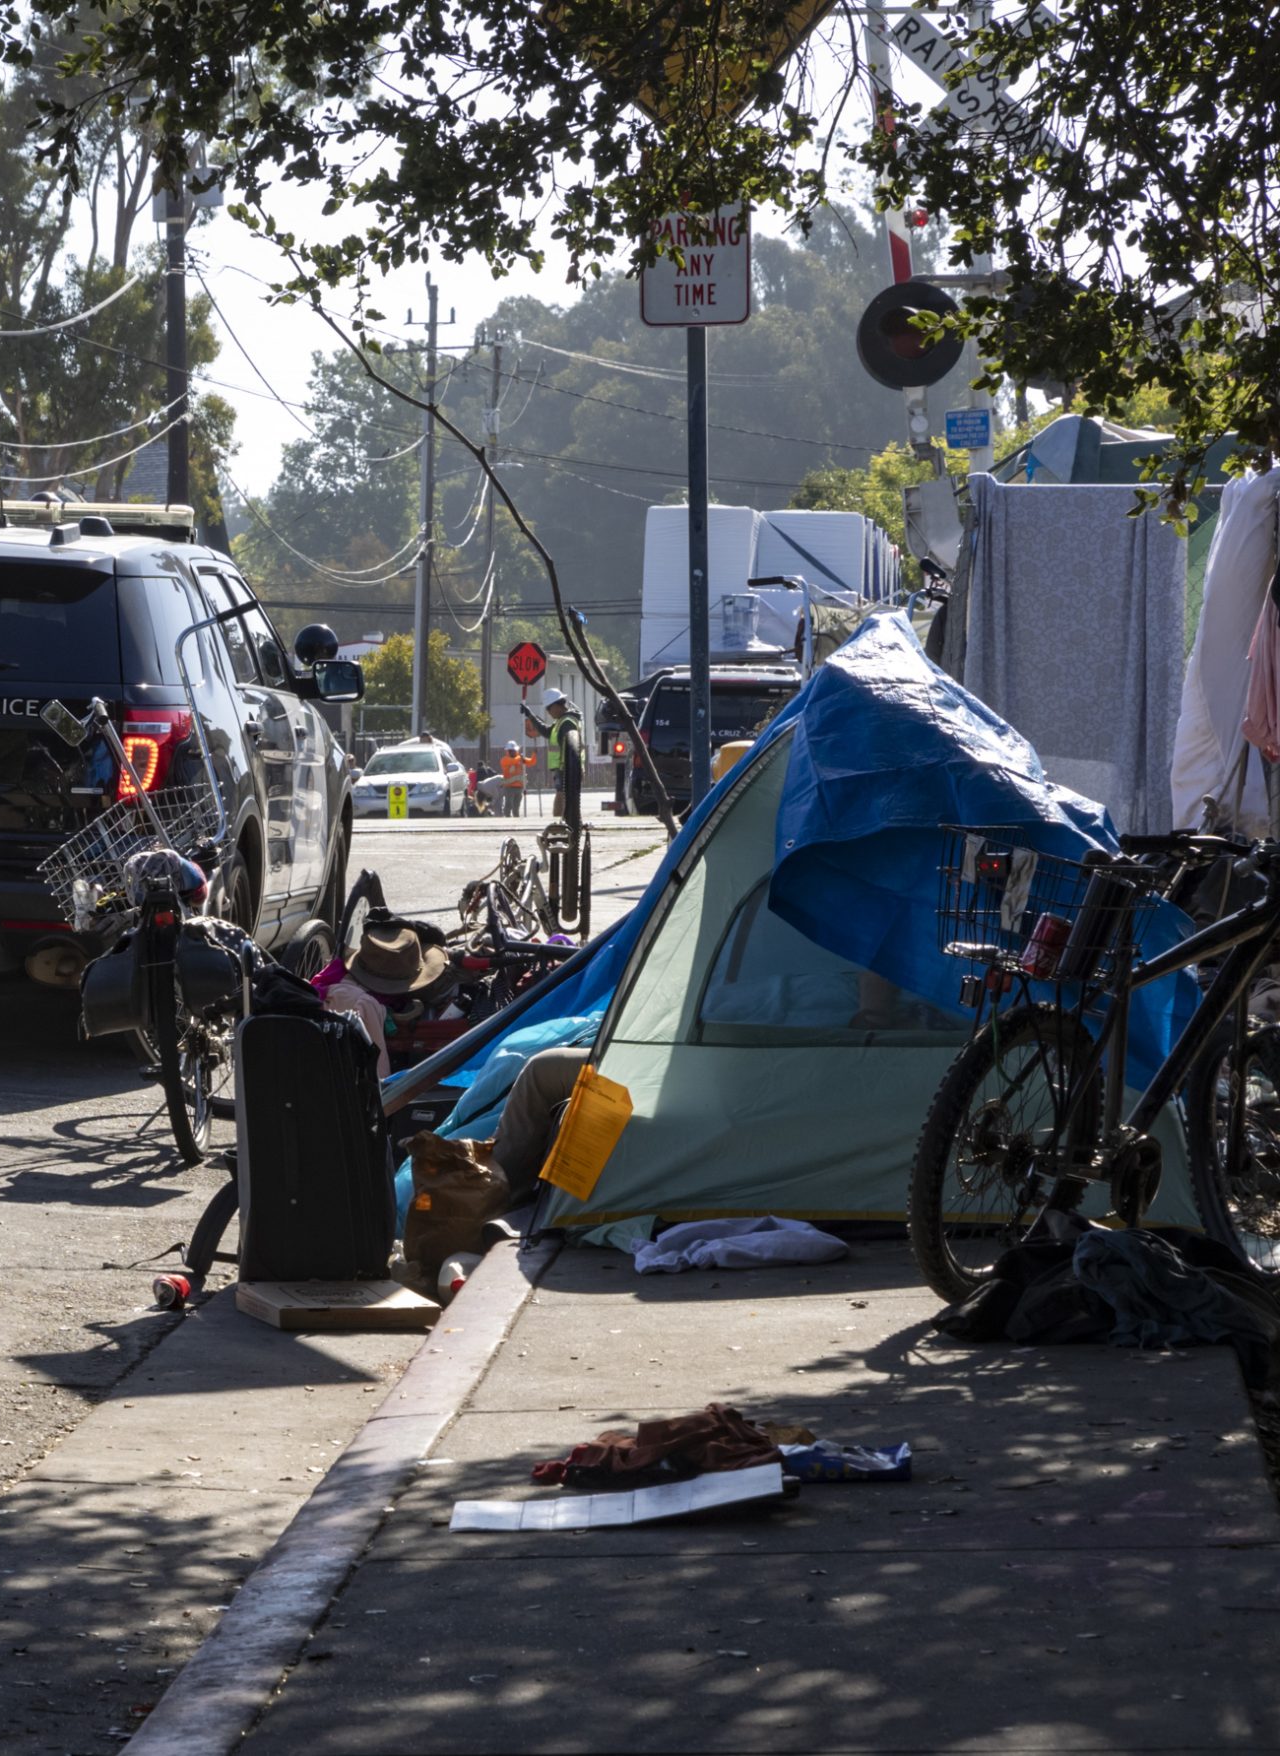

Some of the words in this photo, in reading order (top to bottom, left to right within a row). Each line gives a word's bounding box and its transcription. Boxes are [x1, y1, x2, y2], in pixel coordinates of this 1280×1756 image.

[650, 215, 741, 247] PARNG
[674, 282, 717, 306] TIME
[512, 655, 540, 671] SLOW
